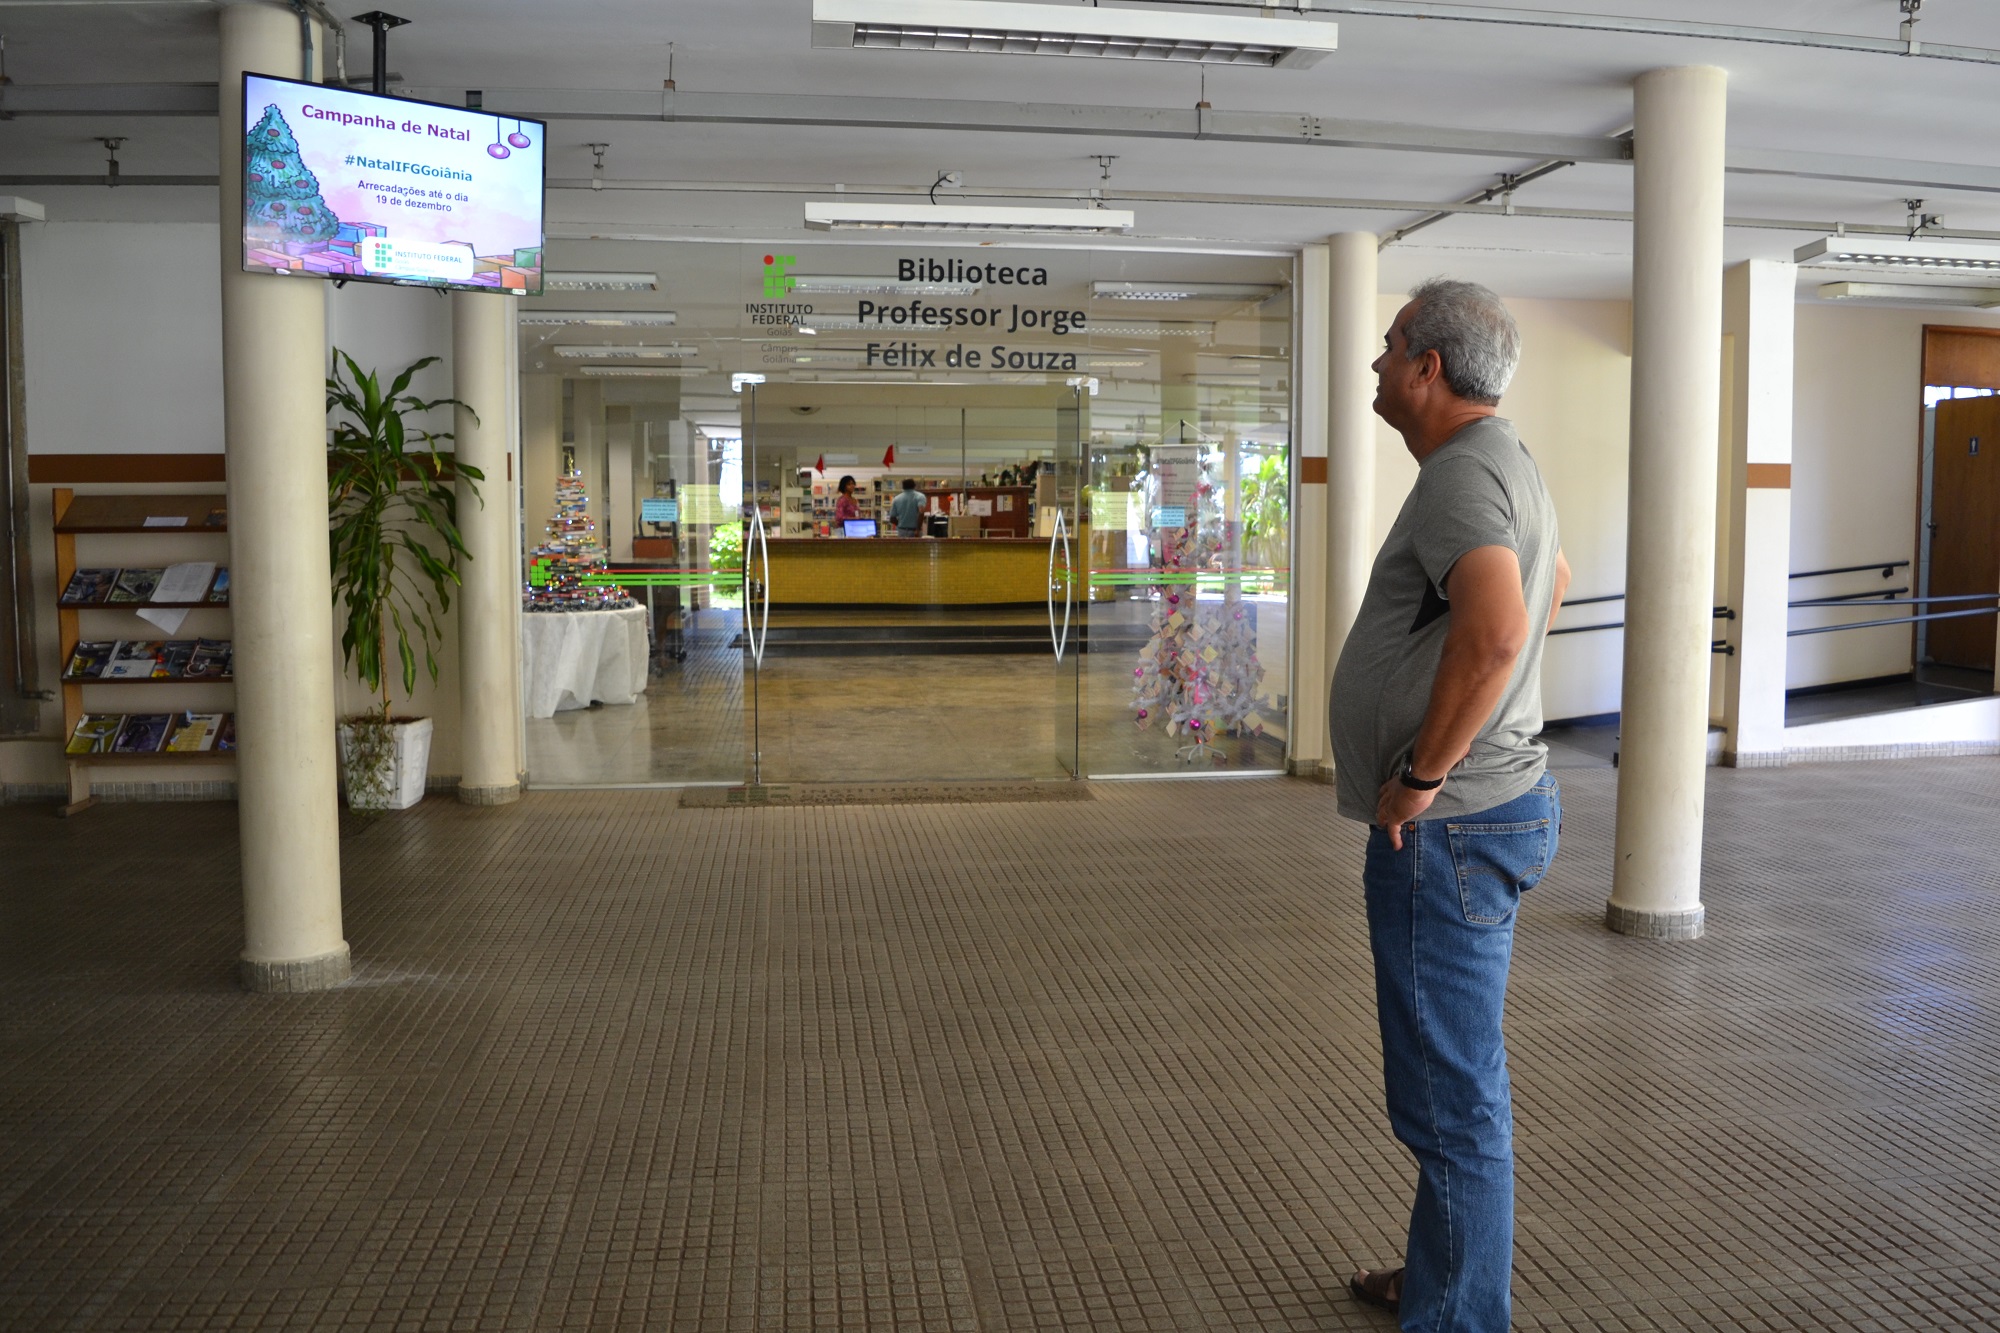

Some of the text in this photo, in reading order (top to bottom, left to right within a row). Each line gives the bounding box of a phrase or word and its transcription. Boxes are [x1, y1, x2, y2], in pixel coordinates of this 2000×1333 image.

[302, 104, 471, 142] Campanha de Natal
[344, 154, 473, 182] #NatalIFGGoiânia
[358, 180, 469, 202] Arrecadações até o dia
[376, 195, 452, 213] 19 de dezembro
[395, 251, 463, 264] INSTITUTO FEDERAL
[897, 258, 1048, 286] Biblioteca
[746, 303, 814, 316] INSTITUTO
[752, 315, 807, 326] FEDERAL
[857, 300, 1087, 335] Professor Jorge
[766, 327, 793, 337] Goiás
[866, 342, 1078, 371] Félix de Souza
